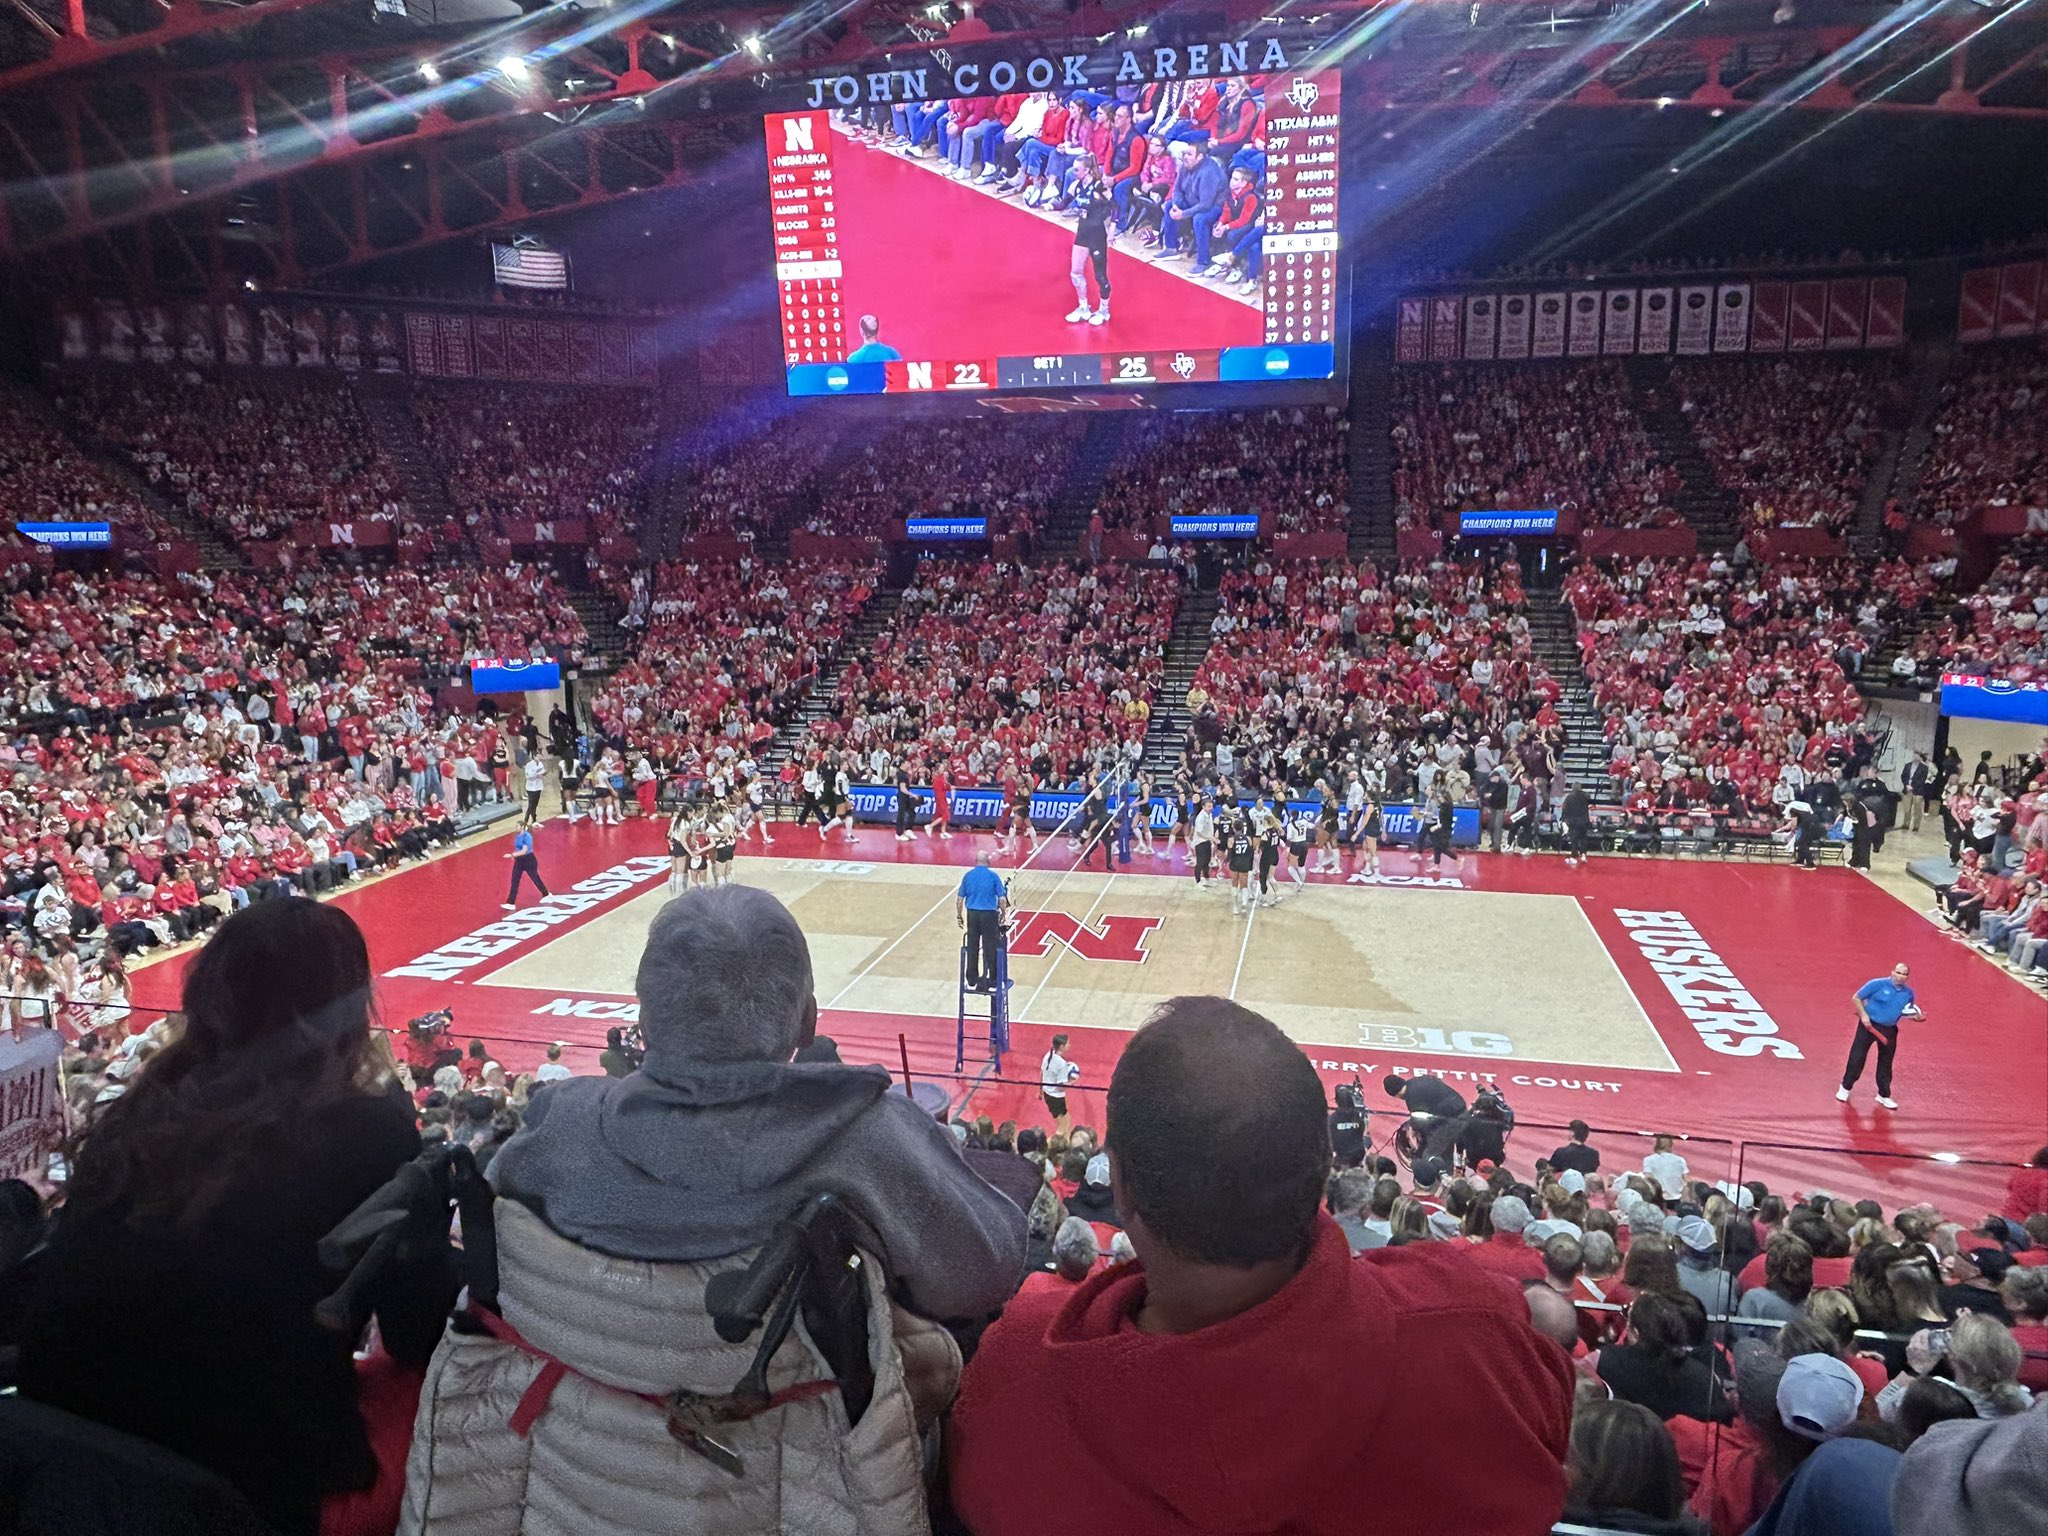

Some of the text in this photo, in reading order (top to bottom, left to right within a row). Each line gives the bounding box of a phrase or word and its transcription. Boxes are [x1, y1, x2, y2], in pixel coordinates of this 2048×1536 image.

[807, 38, 1288, 109] JOHN COOK ARENA
[1274, 116, 1310, 131] TEXAS
[1311, 114, 1338, 128] A&M
[783, 117, 814, 151] N
[1308, 135, 1325, 148] HIT
[777, 153, 828, 167] NEBRASKA
[1295, 169, 1335, 182] ASSISTS
[1266, 186, 1335, 200] 2.0 BLOCKS
[1309, 203, 1334, 215] DIGS
[776, 219, 809, 231] BLOCKS
[1287, 239, 1294, 247] K
[1323, 237, 1331, 246] D
[1270, 251, 1330, 266] 1 0 0 1
[1268, 267, 1331, 282] 2 0 0 0
[1285, 300, 1294, 312] 0
[1302, 299, 1312, 311] 0
[1285, 316, 1294, 328] 0
[1302, 315, 1311, 327] 0
[1323, 314, 1328, 326] 1
[1302, 330, 1311, 342] 0
[1033, 356, 1063, 370] SET 1
[1119, 356, 1148, 378] 25
[907, 361, 932, 389] N
[953, 364, 981, 384] 22
[908, 524, 984, 534] CHAMPIONS WIN HERE
[1172, 522, 1256, 532] CHAMPIONS WIN HERE
[1462, 517, 1554, 529] CHAMPIONS WIN HERE
[330, 523, 354, 544] N
[534, 522, 555, 542] N
[1235, 844, 1248, 854] 37
[381, 855, 672, 981] NEBRASKA
[1007, 909, 1167, 965] N
[1613, 908, 1805, 1060] HUSKERS
[530, 998, 640, 1022] NCA
[1392, 1066, 1497, 1083] PETTIT
[1511, 1075, 1623, 1093] COURT
